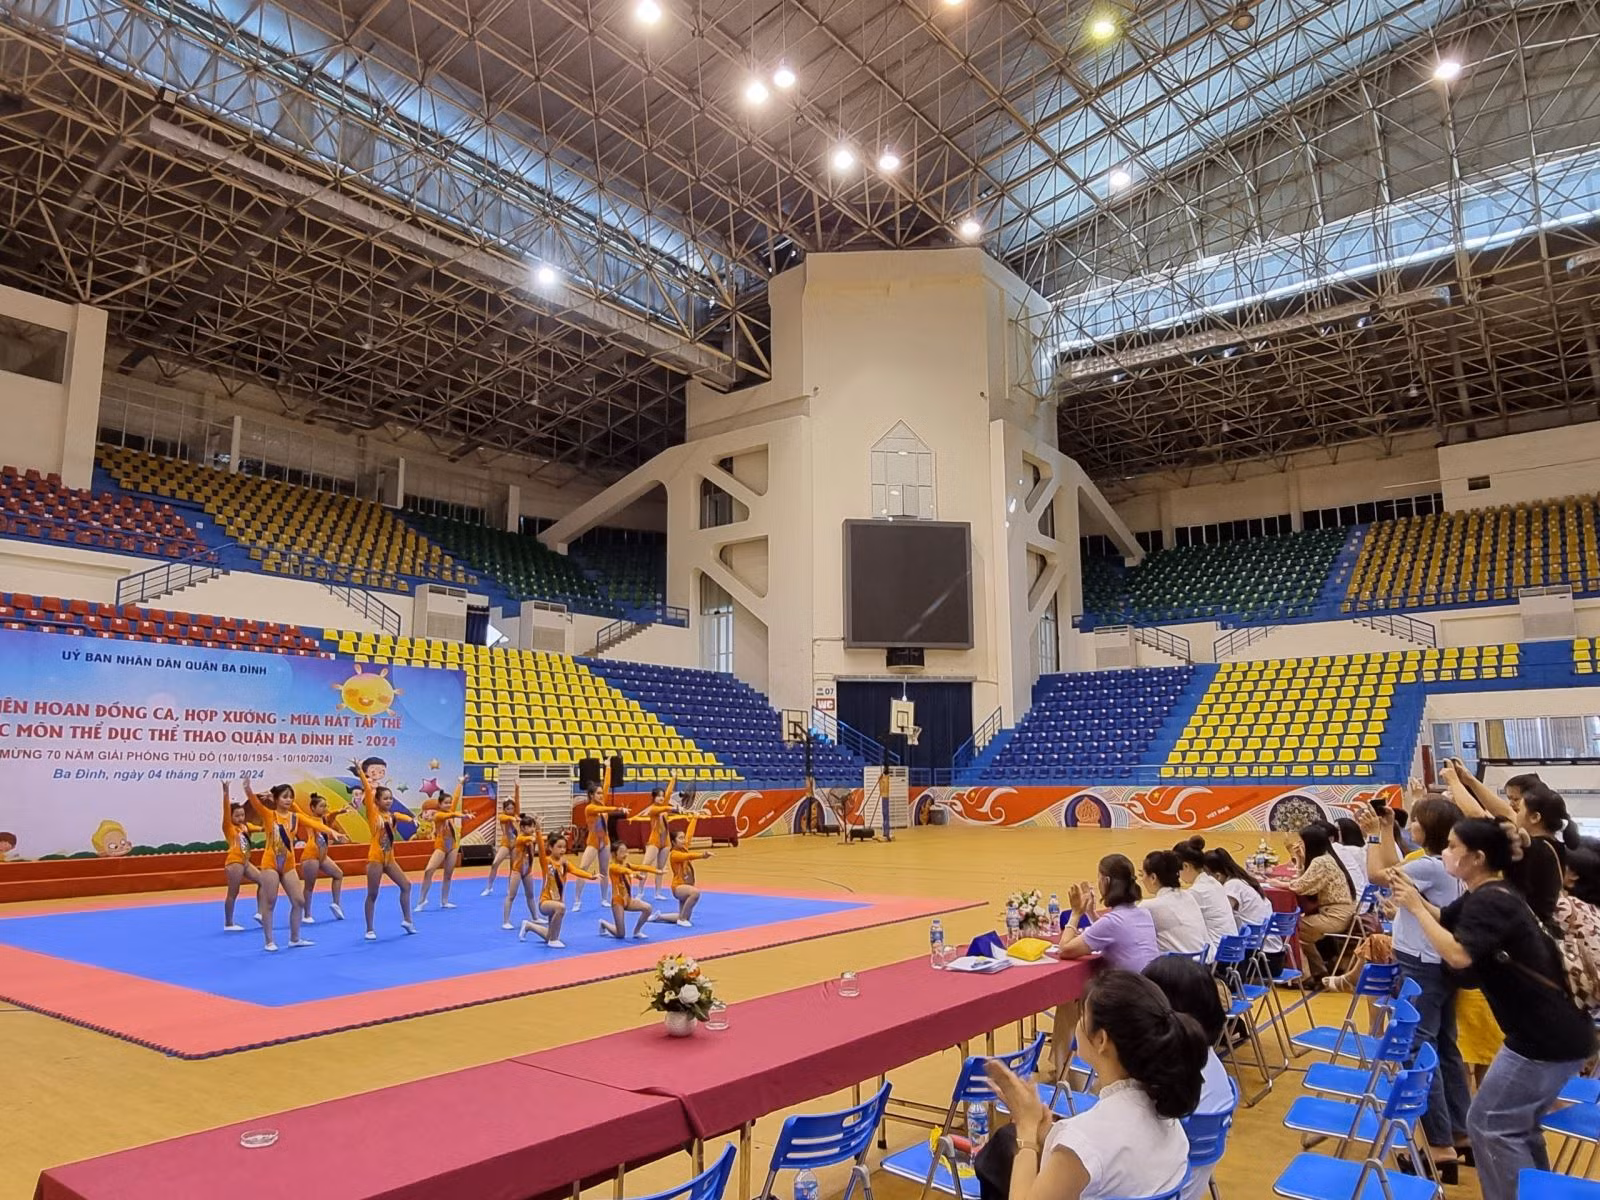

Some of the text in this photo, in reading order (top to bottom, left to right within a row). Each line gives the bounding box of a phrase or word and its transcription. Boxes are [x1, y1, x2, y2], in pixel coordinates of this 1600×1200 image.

[85, 652, 112, 664] BAN
[116, 654, 152, 667] NHÂN
[156, 657, 181, 669] DÂN
[185, 660, 218, 673] QUẬN
[221, 663, 236, 673] BA
[239, 664, 267, 675] ĐÌNH
[34, 701, 89, 717] HOAN
[153, 707, 180, 722] CA,
[184, 709, 218, 725] HỢP
[290, 712, 320, 726] MÚA
[324, 713, 351, 727] HÁT
[817, 700, 833, 709] WC
[16, 721, 63, 738] MÔN
[69, 721, 104, 739] THỂ
[108, 727, 143, 743] DỤC
[148, 723, 180, 742] THỂ
[183, 729, 227, 743] THAO
[231, 729, 275, 746] QUẬN
[279, 732, 297, 745] BA
[366, 735, 397, 747] 2024
[0, 746, 42, 759] MỪNG
[47, 750, 61, 760] 70
[65, 748, 94, 760] NĂM
[98, 749, 123, 761] GIẢI
[126, 749, 170, 761] PHÓNG
[173, 751, 196, 762] THỦ
[218, 752, 273, 764] (10/10/1954
[283, 754, 333, 764] 10/10/2024)
[53, 768, 265, 781] Ba Đình, ngày 04 tháng 7 năm 2024
